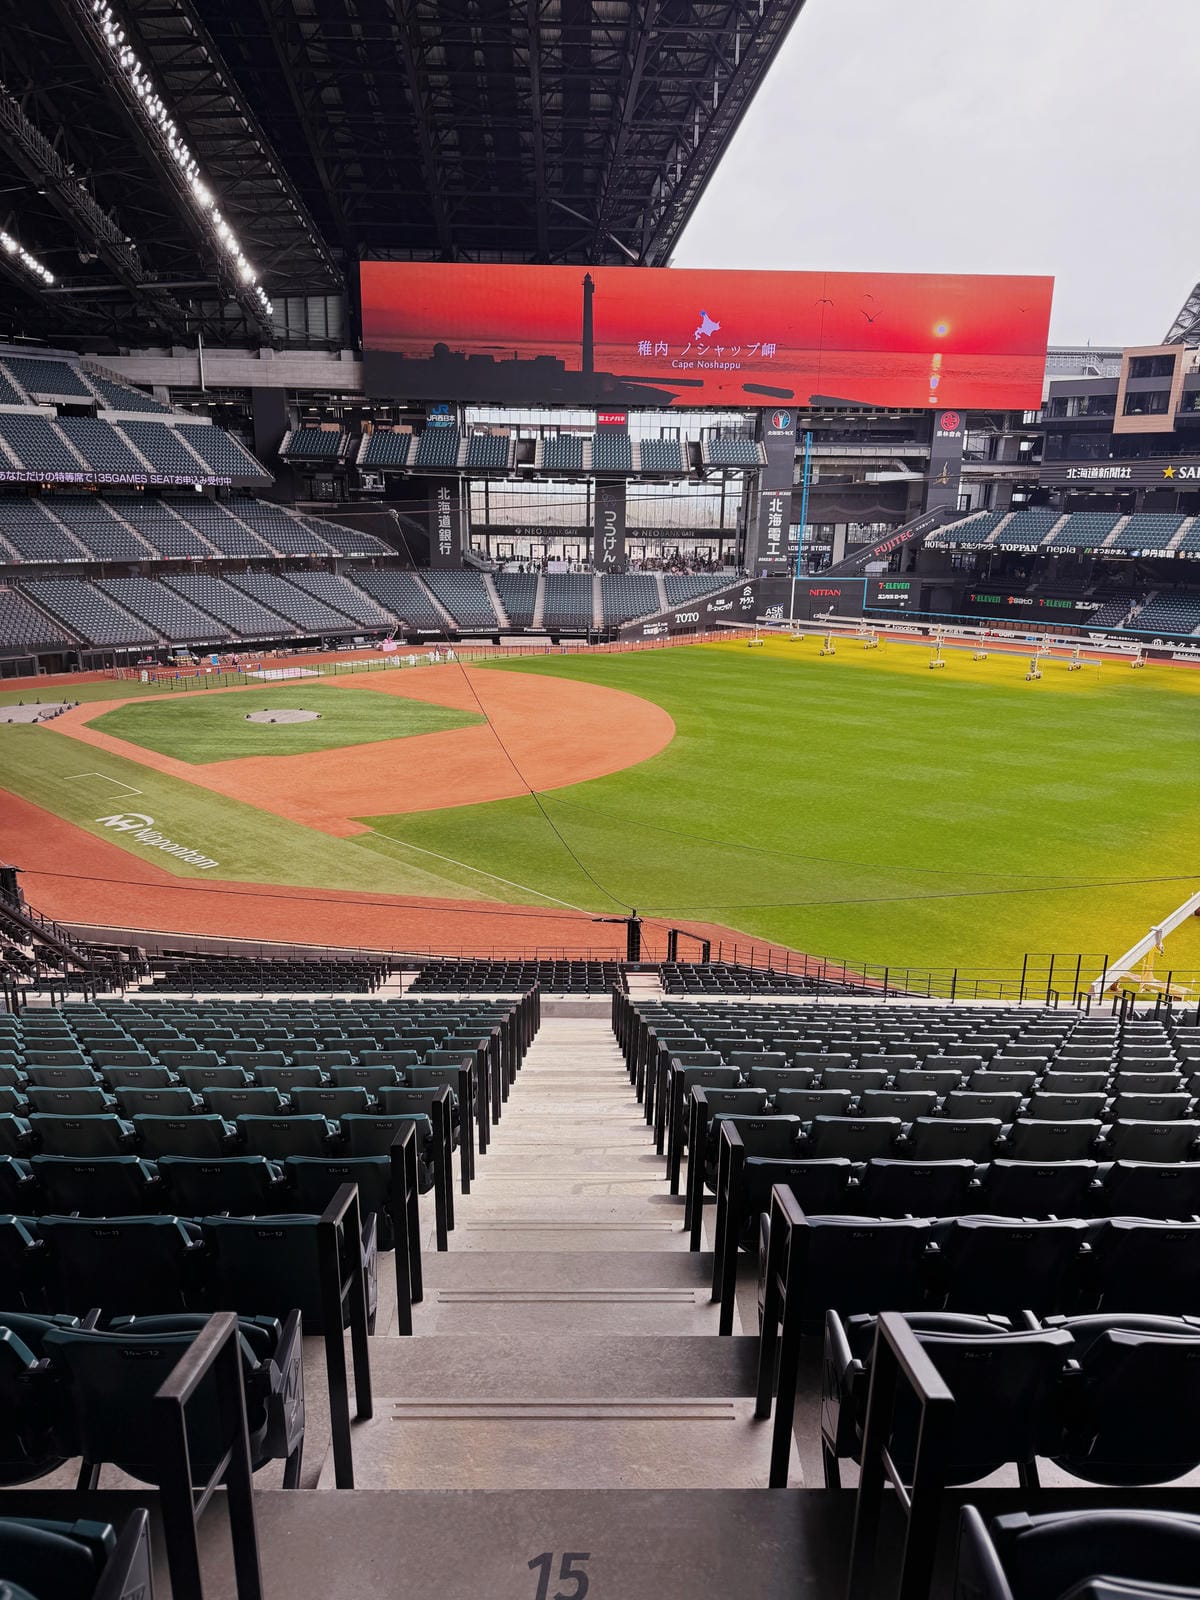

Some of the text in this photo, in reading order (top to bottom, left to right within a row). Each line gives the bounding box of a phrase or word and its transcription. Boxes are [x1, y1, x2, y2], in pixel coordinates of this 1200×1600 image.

[638, 340, 776, 358] 稚内 ノシャップ岬
[672, 360, 741, 370] Cape Noshappu
[431, 404, 449, 414] JR
[1066, 467, 1132, 479] 北海道新聞社
[438, 487, 451, 555] 北海道銀行
[766, 498, 783, 555] 北海電工
[602, 510, 617, 562] つうけん
[874, 529, 914, 556] FUJITEC
[1000, 543, 1039, 552] TOPPAN
[1046, 545, 1076, 553] nepia
[675, 612, 699, 623] TOTO
[766, 605, 784, 616] ASK
[128, 828, 219, 869] Nipponham
[528, 1552, 591, 1600] 15
